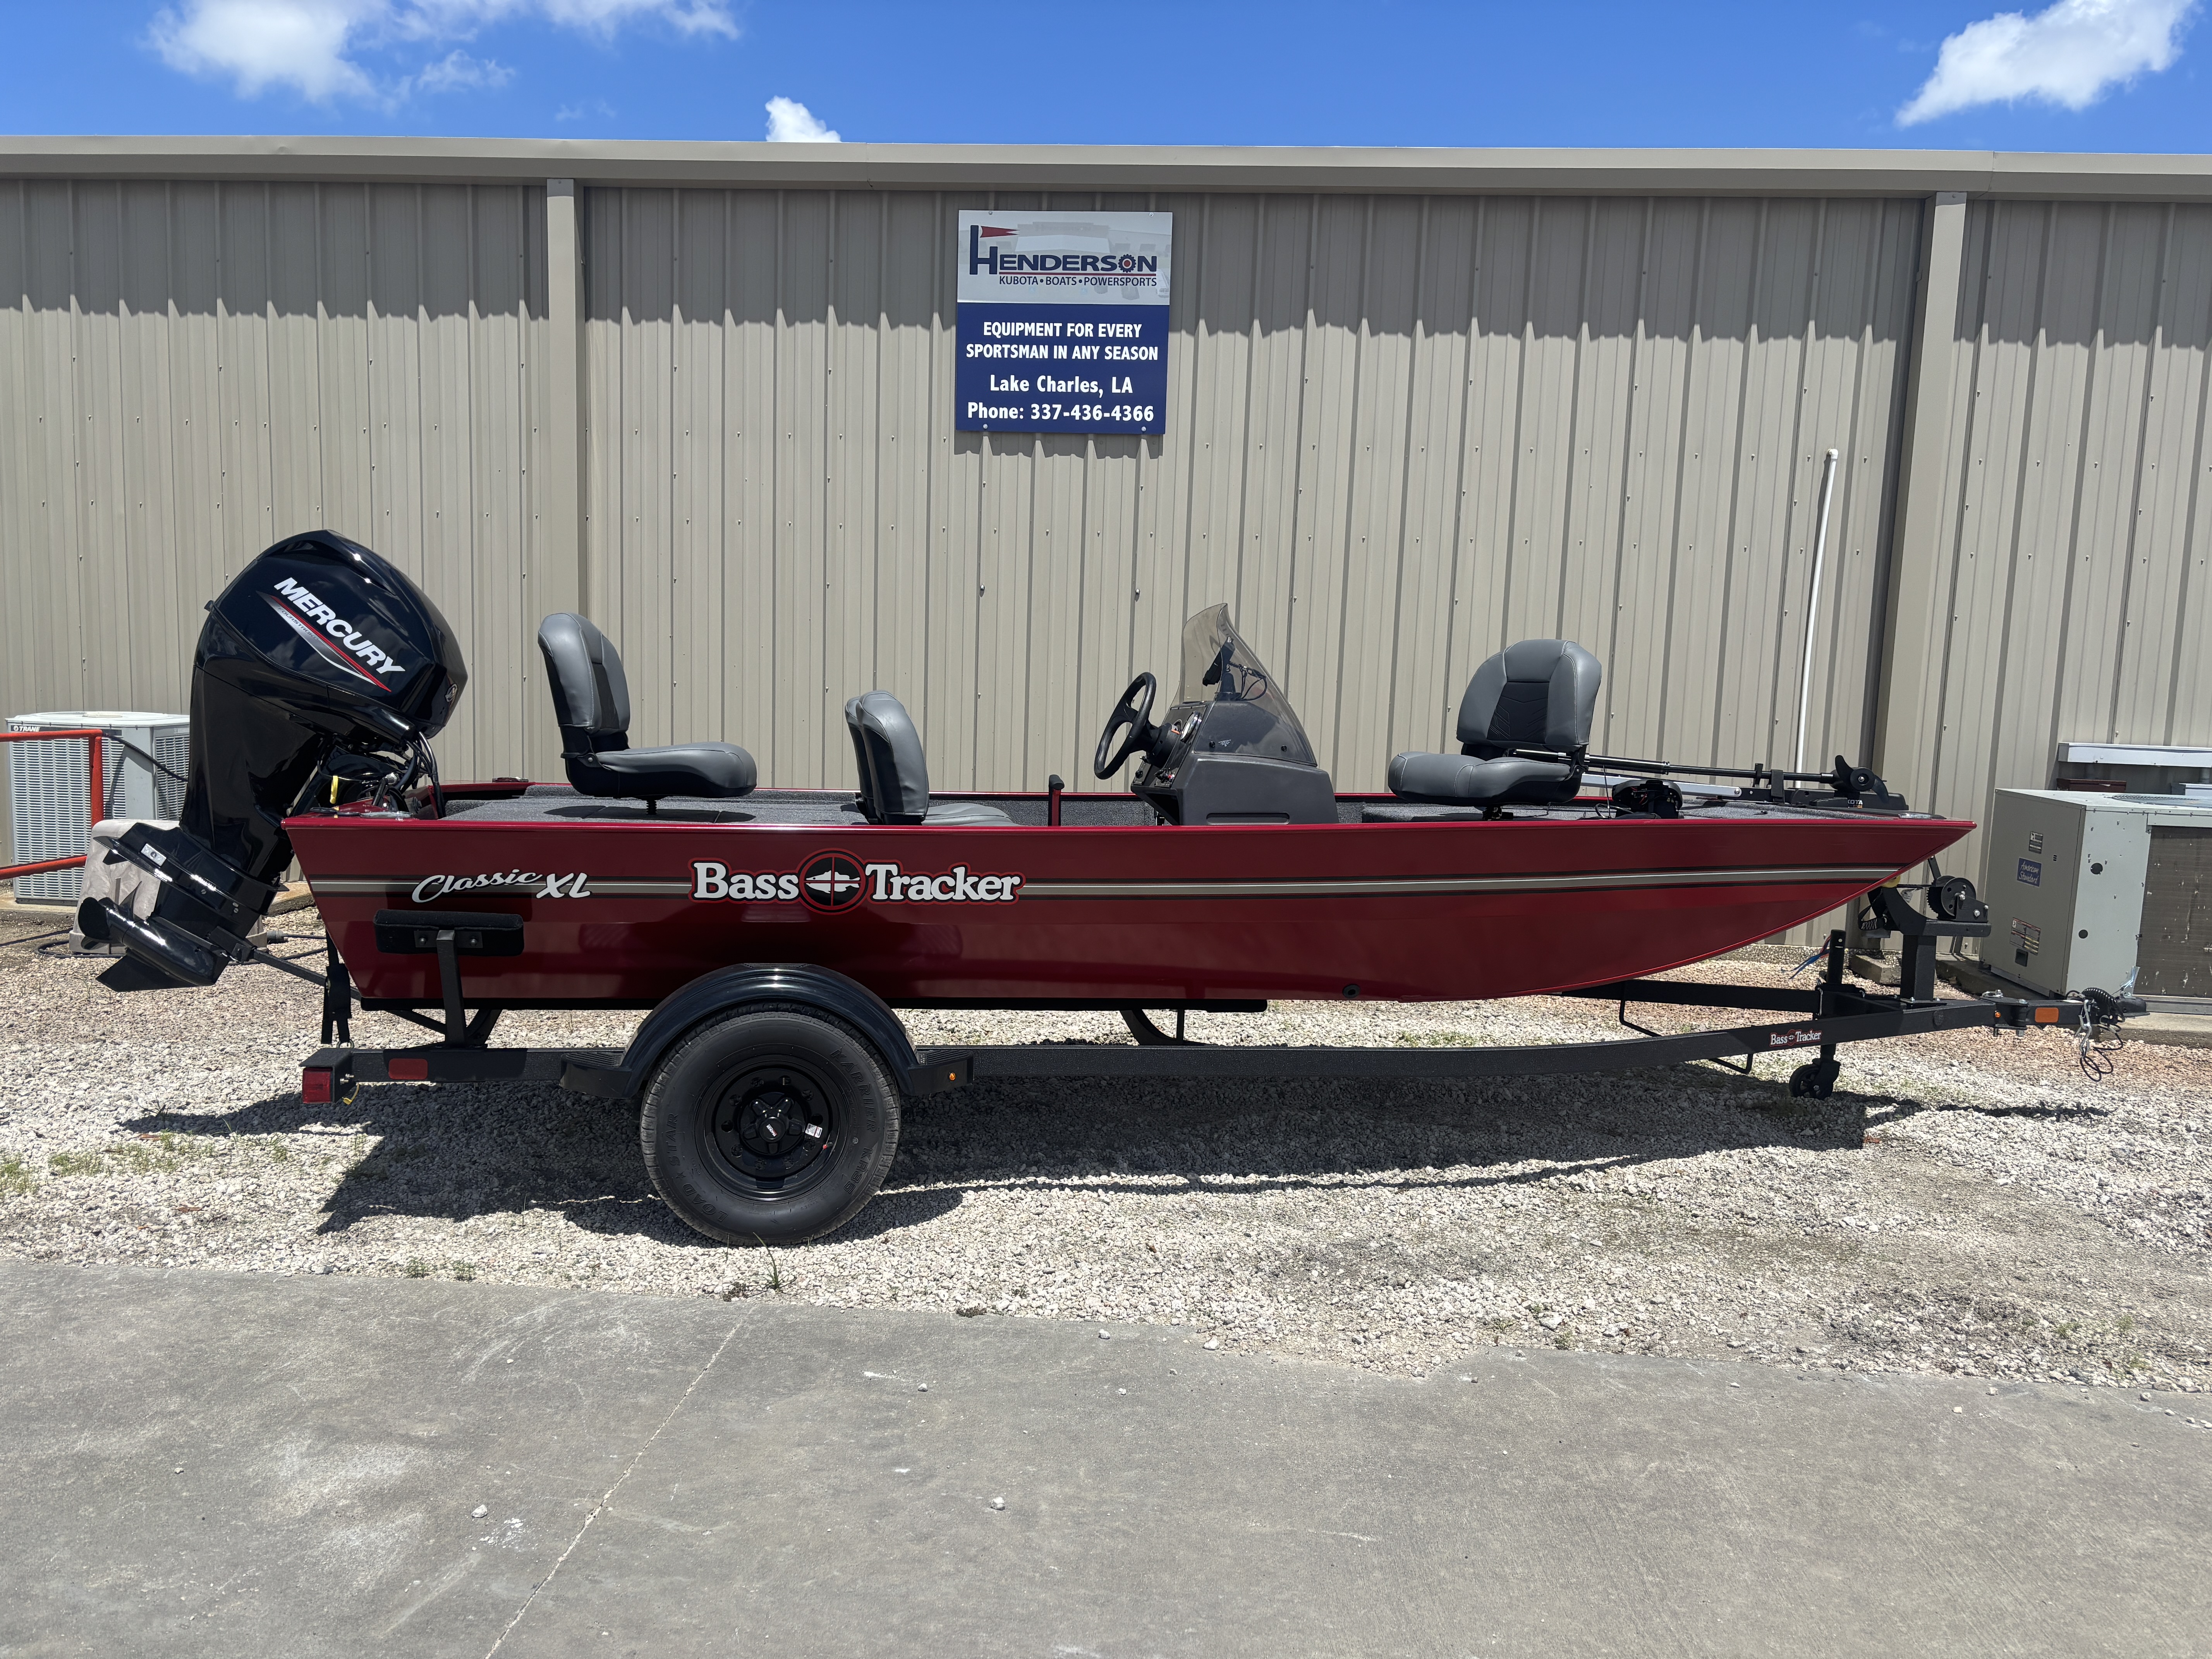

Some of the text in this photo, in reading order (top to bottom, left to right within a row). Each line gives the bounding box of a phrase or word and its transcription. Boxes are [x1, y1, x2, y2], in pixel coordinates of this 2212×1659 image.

[969, 225, 1157, 275] HENDERSON
[999, 276, 1157, 286] KUBOTA BOATS POWERSPORTS
[984, 322, 1142, 338] EQUIPMENT FOR EVERY
[966, 343, 1158, 361] SPORTSMAN IN ANY SEASON
[990, 374, 1133, 398] Lake Charles, LA
[967, 402, 1154, 422] Phone: 337-436-4366
[273, 577, 405, 674] MERCURY
[278, 606, 319, 640] FOURSTROKE
[2018, 871, 2039, 884] Standard
[2020, 861, 2039, 874] American
[412, 869, 591, 903] Classic XL
[694, 862, 1020, 900] Bass Tracker
[1771, 1030, 1821, 1045] Bass Tracker
[830, 1049, 876, 1132] KARRIER
[666, 1113, 728, 1222] LOAD STAR
